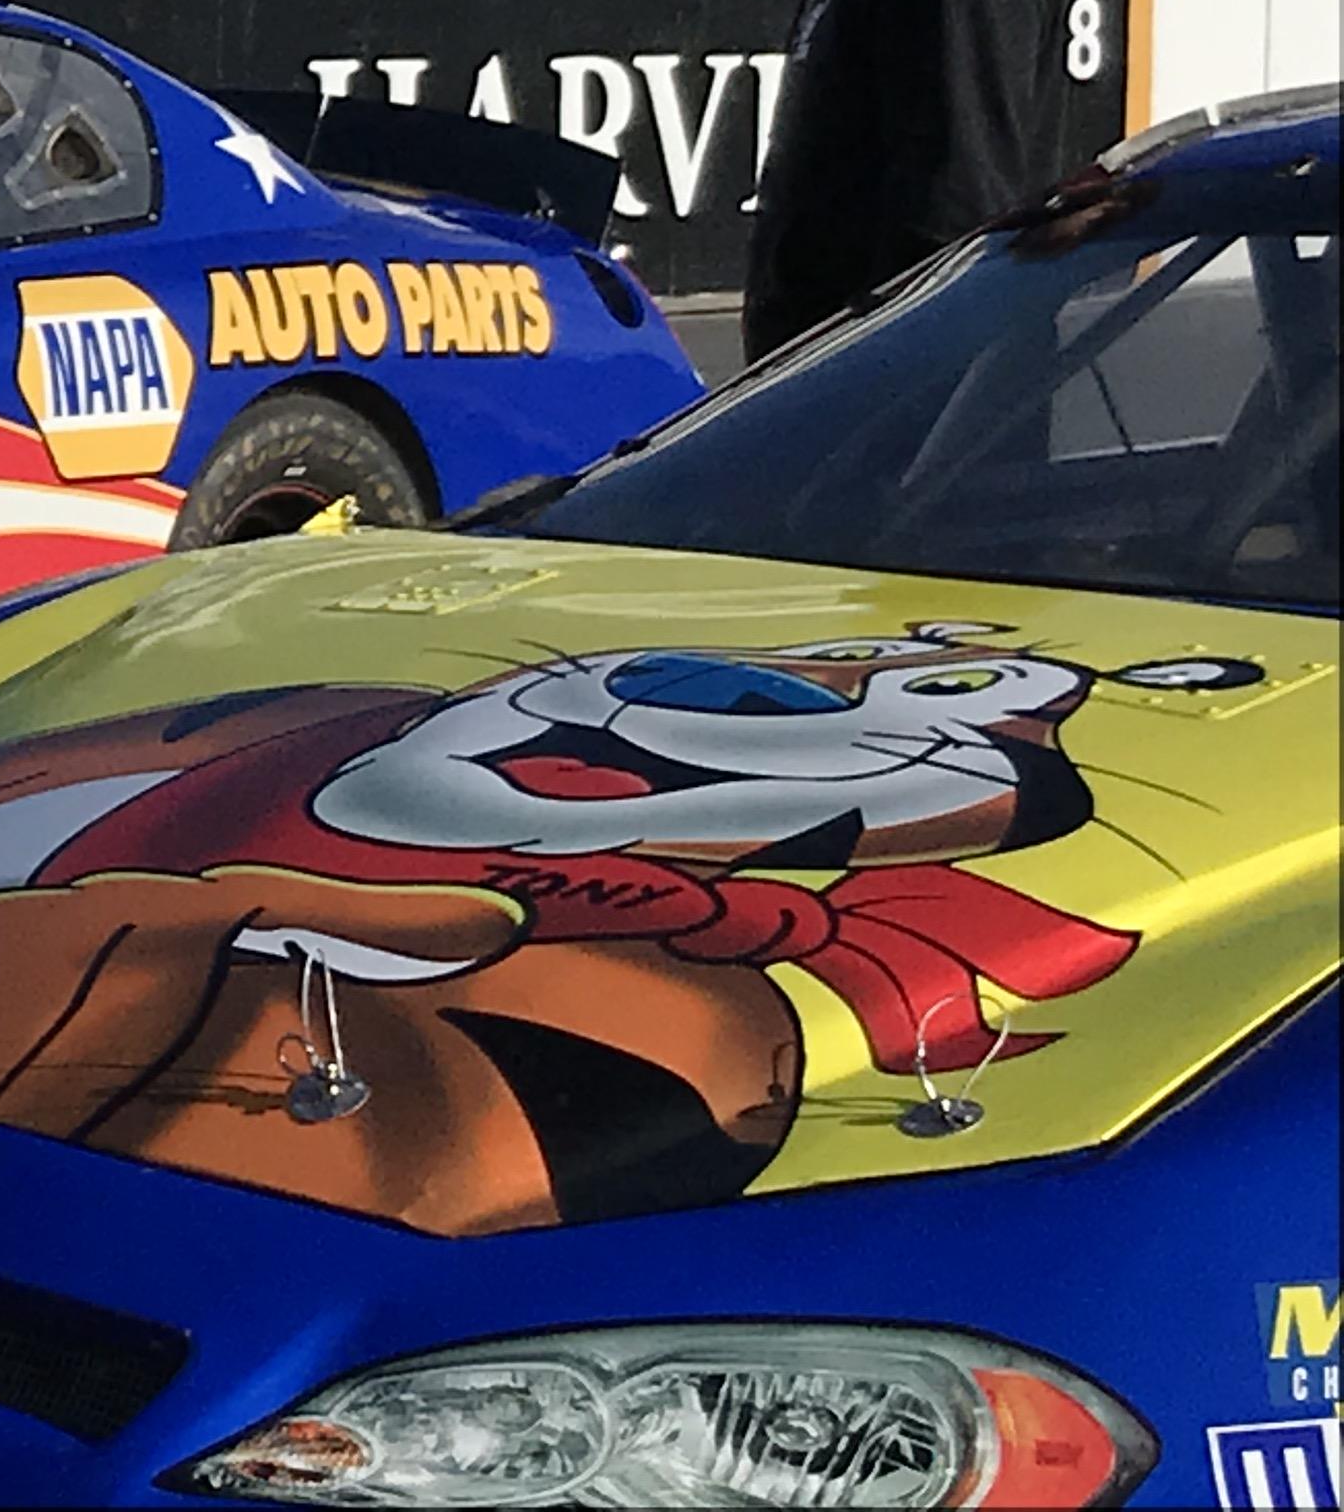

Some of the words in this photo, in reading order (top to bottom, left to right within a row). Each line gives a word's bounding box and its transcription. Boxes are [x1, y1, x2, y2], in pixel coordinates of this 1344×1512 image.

[208, 261, 388, 365] AUTO
[386, 261, 553, 356] PARTS
[39, 316, 170, 418] NAPA
